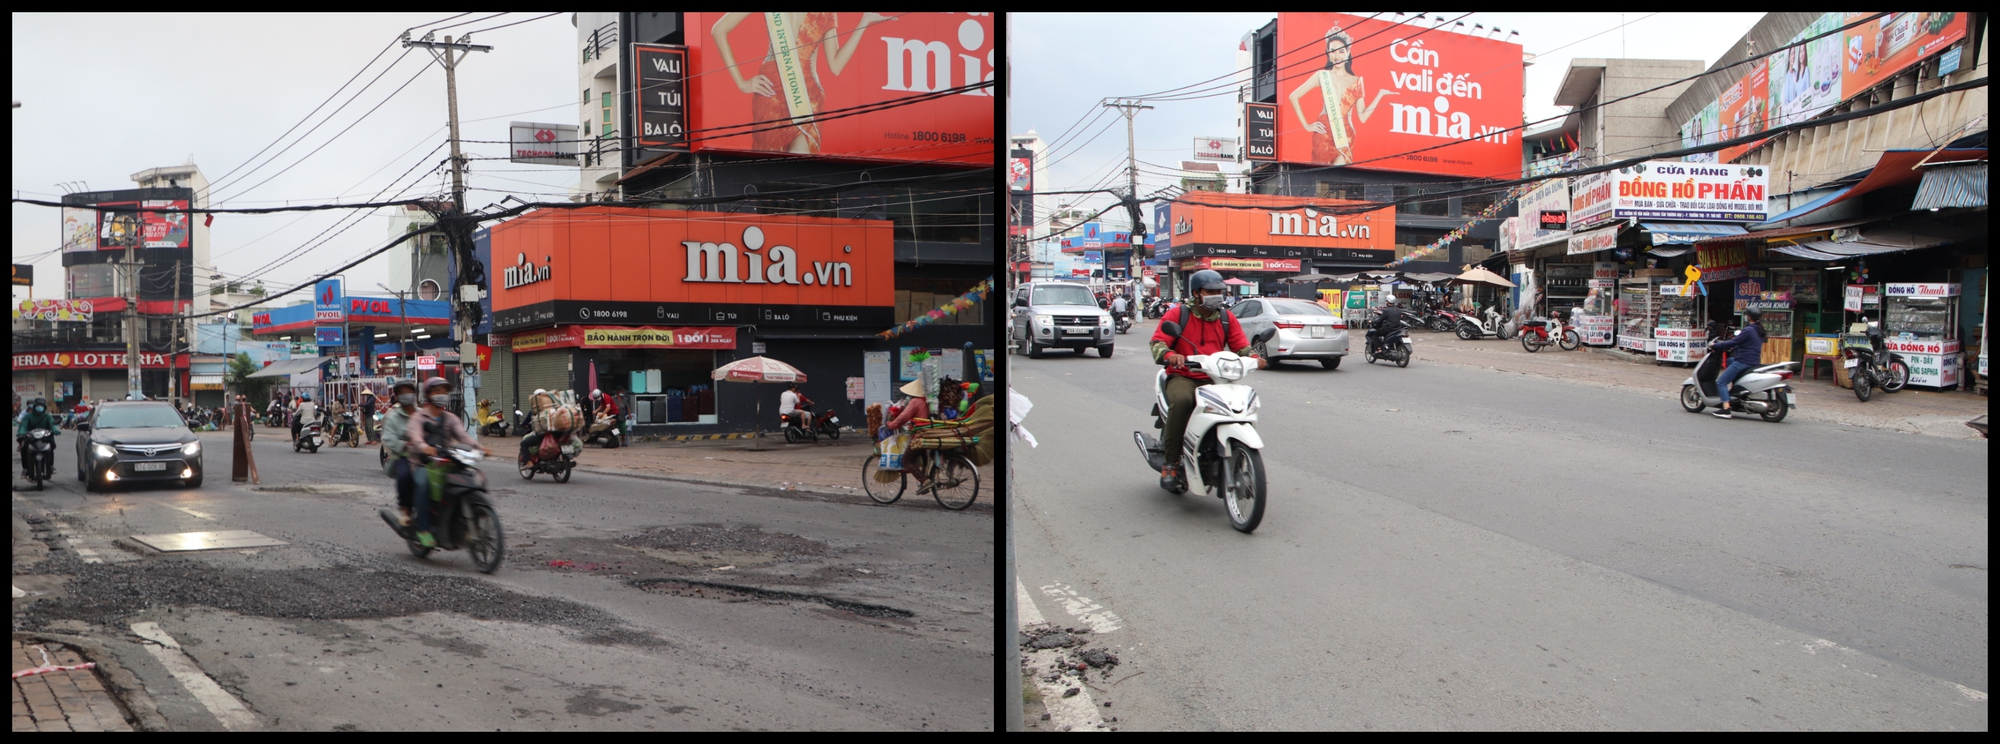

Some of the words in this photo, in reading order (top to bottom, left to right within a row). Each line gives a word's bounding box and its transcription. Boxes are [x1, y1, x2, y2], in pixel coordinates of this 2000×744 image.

[881, 19, 994, 97] mi
[1390, 38, 1439, 68] Cần
[652, 58, 680, 74] VALI
[776, 28, 802, 108] INTERNATIONAL
[1390, 69, 1433, 93] vali
[1436, 72, 1482, 100] đến
[658, 90, 682, 106] TÚI
[1256, 110, 1273, 119] VALI
[1328, 95, 1343, 140] INTERNATIONAL
[1389, 96, 1508, 144] mia.vn
[644, 120, 682, 138] BALÔ
[1259, 128, 1273, 137] TÚI
[884, 132, 910, 141] Hotline
[912, 132, 938, 142] 1800
[940, 132, 966, 143] 6198
[516, 150, 577, 160] TECHCOMBANK
[1250, 144, 1273, 154] BALÔ
[1657, 164, 1685, 175] CỬA
[1690, 166, 1728, 176] HÀNG
[1535, 189, 1544, 201] ĐIỆN
[1552, 180, 1564, 195] DỤNG
[1592, 178, 1611, 205] PHẤN
[1619, 176, 1667, 198] ĐỒNG
[1672, 178, 1695, 198] HỒ
[1698, 178, 1765, 201] PHẤN
[1656, 199, 1664, 208] SỬA
[1698, 200, 1706, 209] CÁC
[1707, 202, 1715, 211] LOẠI
[1716, 202, 1727, 210] ĐỒNG
[1728, 202, 1733, 210] HỒ
[1268, 205, 1370, 239] mia.vn
[681, 225, 852, 286] mia.vn
[1698, 245, 1712, 269] SỬA
[1712, 251, 1717, 267] &
[1718, 243, 1727, 266] MỞ
[503, 252, 551, 289] mia.vn
[1596, 268, 1609, 278] ĐỒNG
[1610, 268, 1617, 278] HỒ
[1739, 279, 1761, 296] SỬA
[1888, 284, 1905, 294] ĐỒNG
[1906, 284, 1915, 294] HỒ
[1918, 285, 1945, 295] Thanh
[352, 299, 368, 313] PV
[370, 300, 392, 313] OIL
[1759, 300, 1772, 309] CHÌA
[1773, 301, 1790, 309] KHÓA
[587, 332, 606, 342] BẢO
[607, 332, 631, 342] HÀNH
[632, 334, 654, 342] TRỌN
[655, 333, 670, 342] ĐỜI
[677, 334, 682, 342] 1
[705, 335, 709, 343] 1
[1667, 339, 1678, 347] ĐỒNG
[1689, 340, 1699, 348] ĐỒNG
[1900, 341, 1925, 352] ĐỒNG
[1928, 342, 1940, 353] HỒ
[1658, 349, 1669, 358] THAY
[1911, 356, 1919, 364] PIN
[1923, 354, 1934, 364] DÂY
[1921, 368, 1938, 376] SAPHIA
